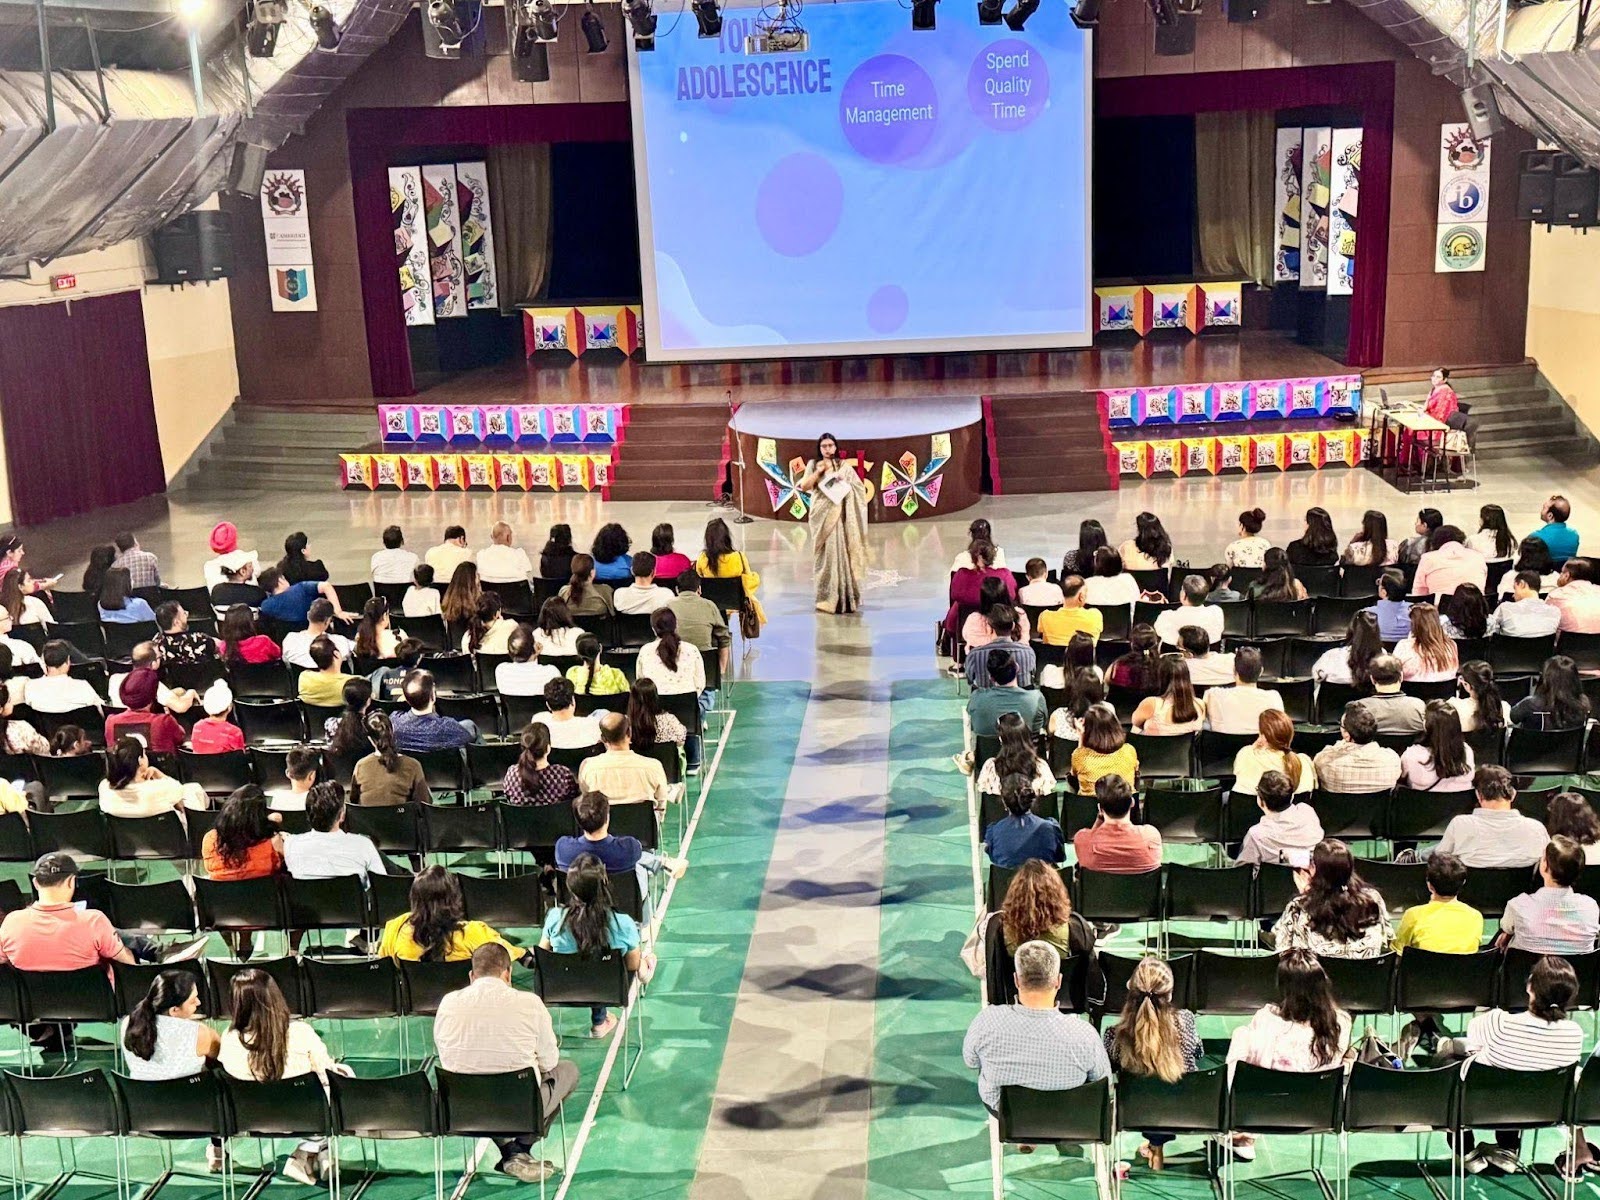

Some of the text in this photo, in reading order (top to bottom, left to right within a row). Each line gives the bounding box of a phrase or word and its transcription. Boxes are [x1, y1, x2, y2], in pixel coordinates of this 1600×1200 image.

[986, 51, 1029, 73] Spend
[677, 58, 832, 101] ADOLESCENCE
[871, 81, 905, 98] Time
[984, 76, 1031, 97] Quality
[846, 104, 933, 126] Management
[992, 101, 1026, 119] Time
